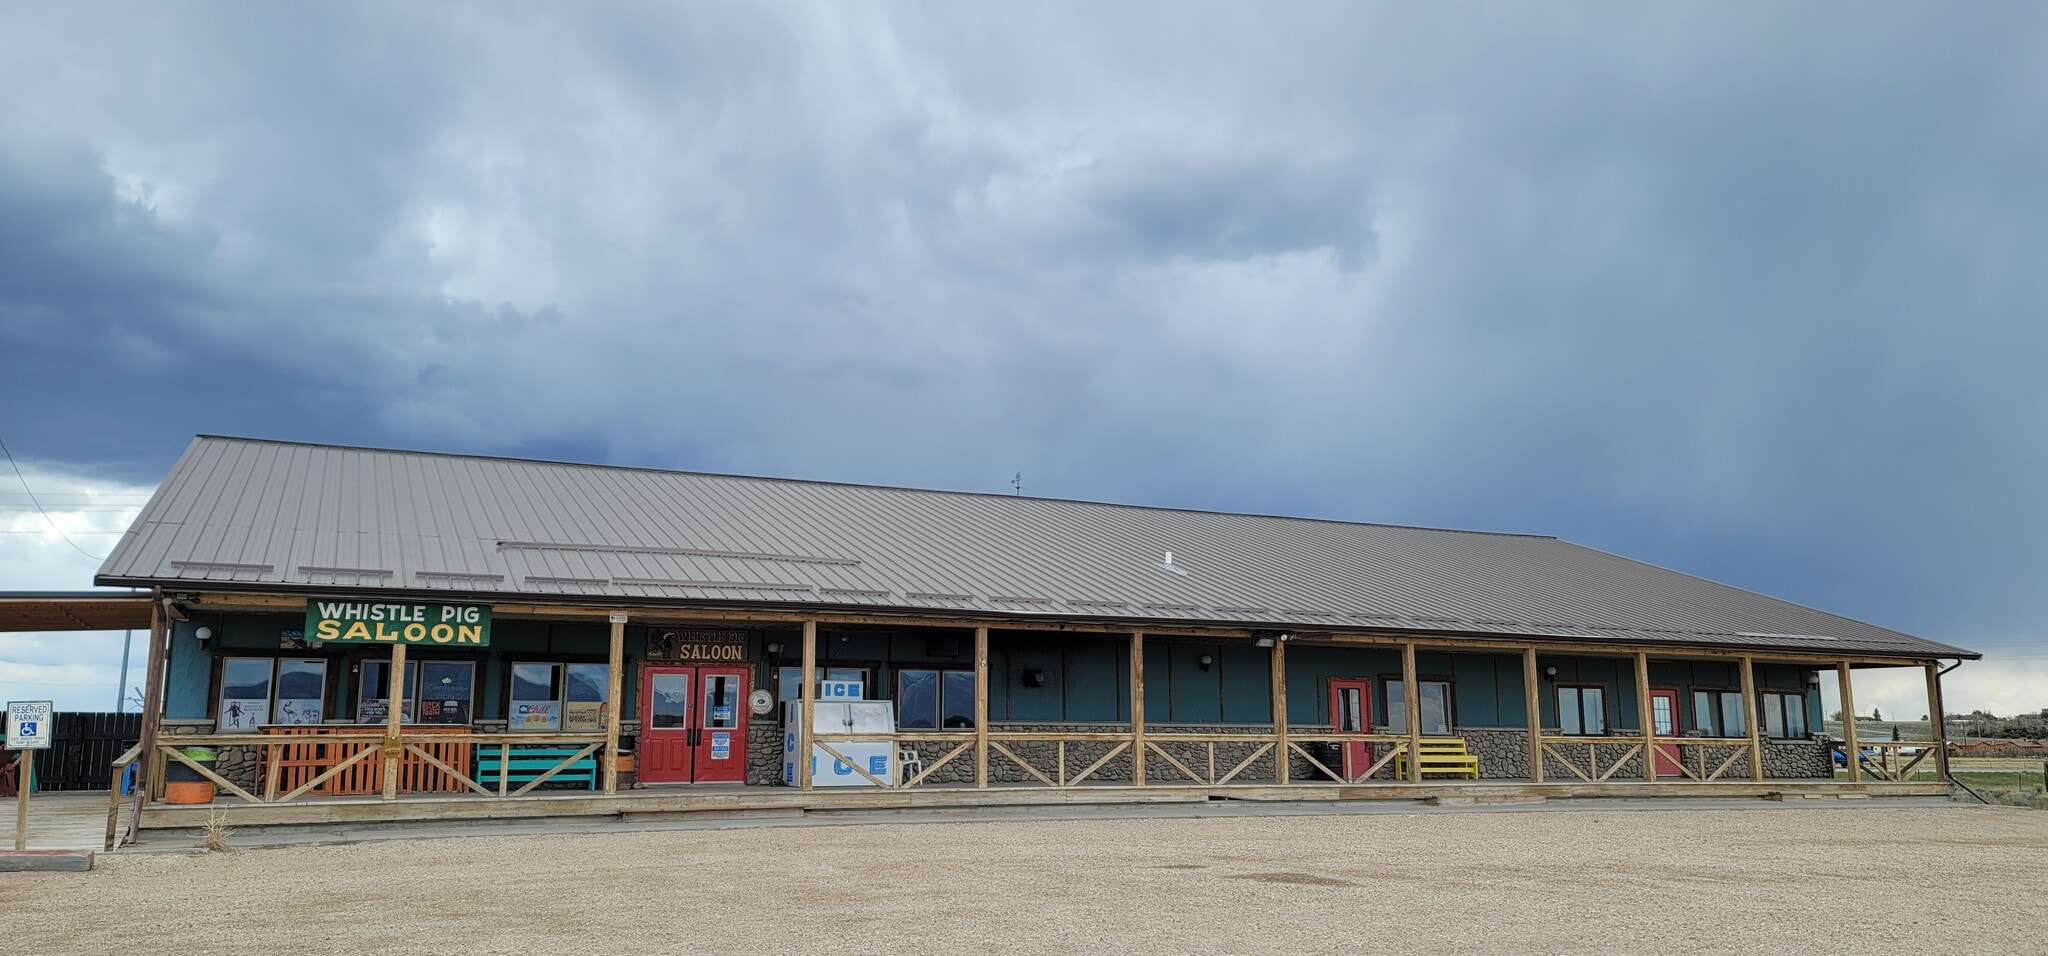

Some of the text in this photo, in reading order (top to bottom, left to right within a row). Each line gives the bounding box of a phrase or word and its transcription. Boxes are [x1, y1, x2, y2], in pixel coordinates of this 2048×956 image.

[317, 602, 480, 623] WHISTLE PIG
[316, 619, 483, 644] SALOON
[676, 630, 746, 643] WHISTLE PIG
[680, 644, 743, 660] SALOON
[825, 683, 860, 697] ICE
[12, 705, 48, 713] RESERVED
